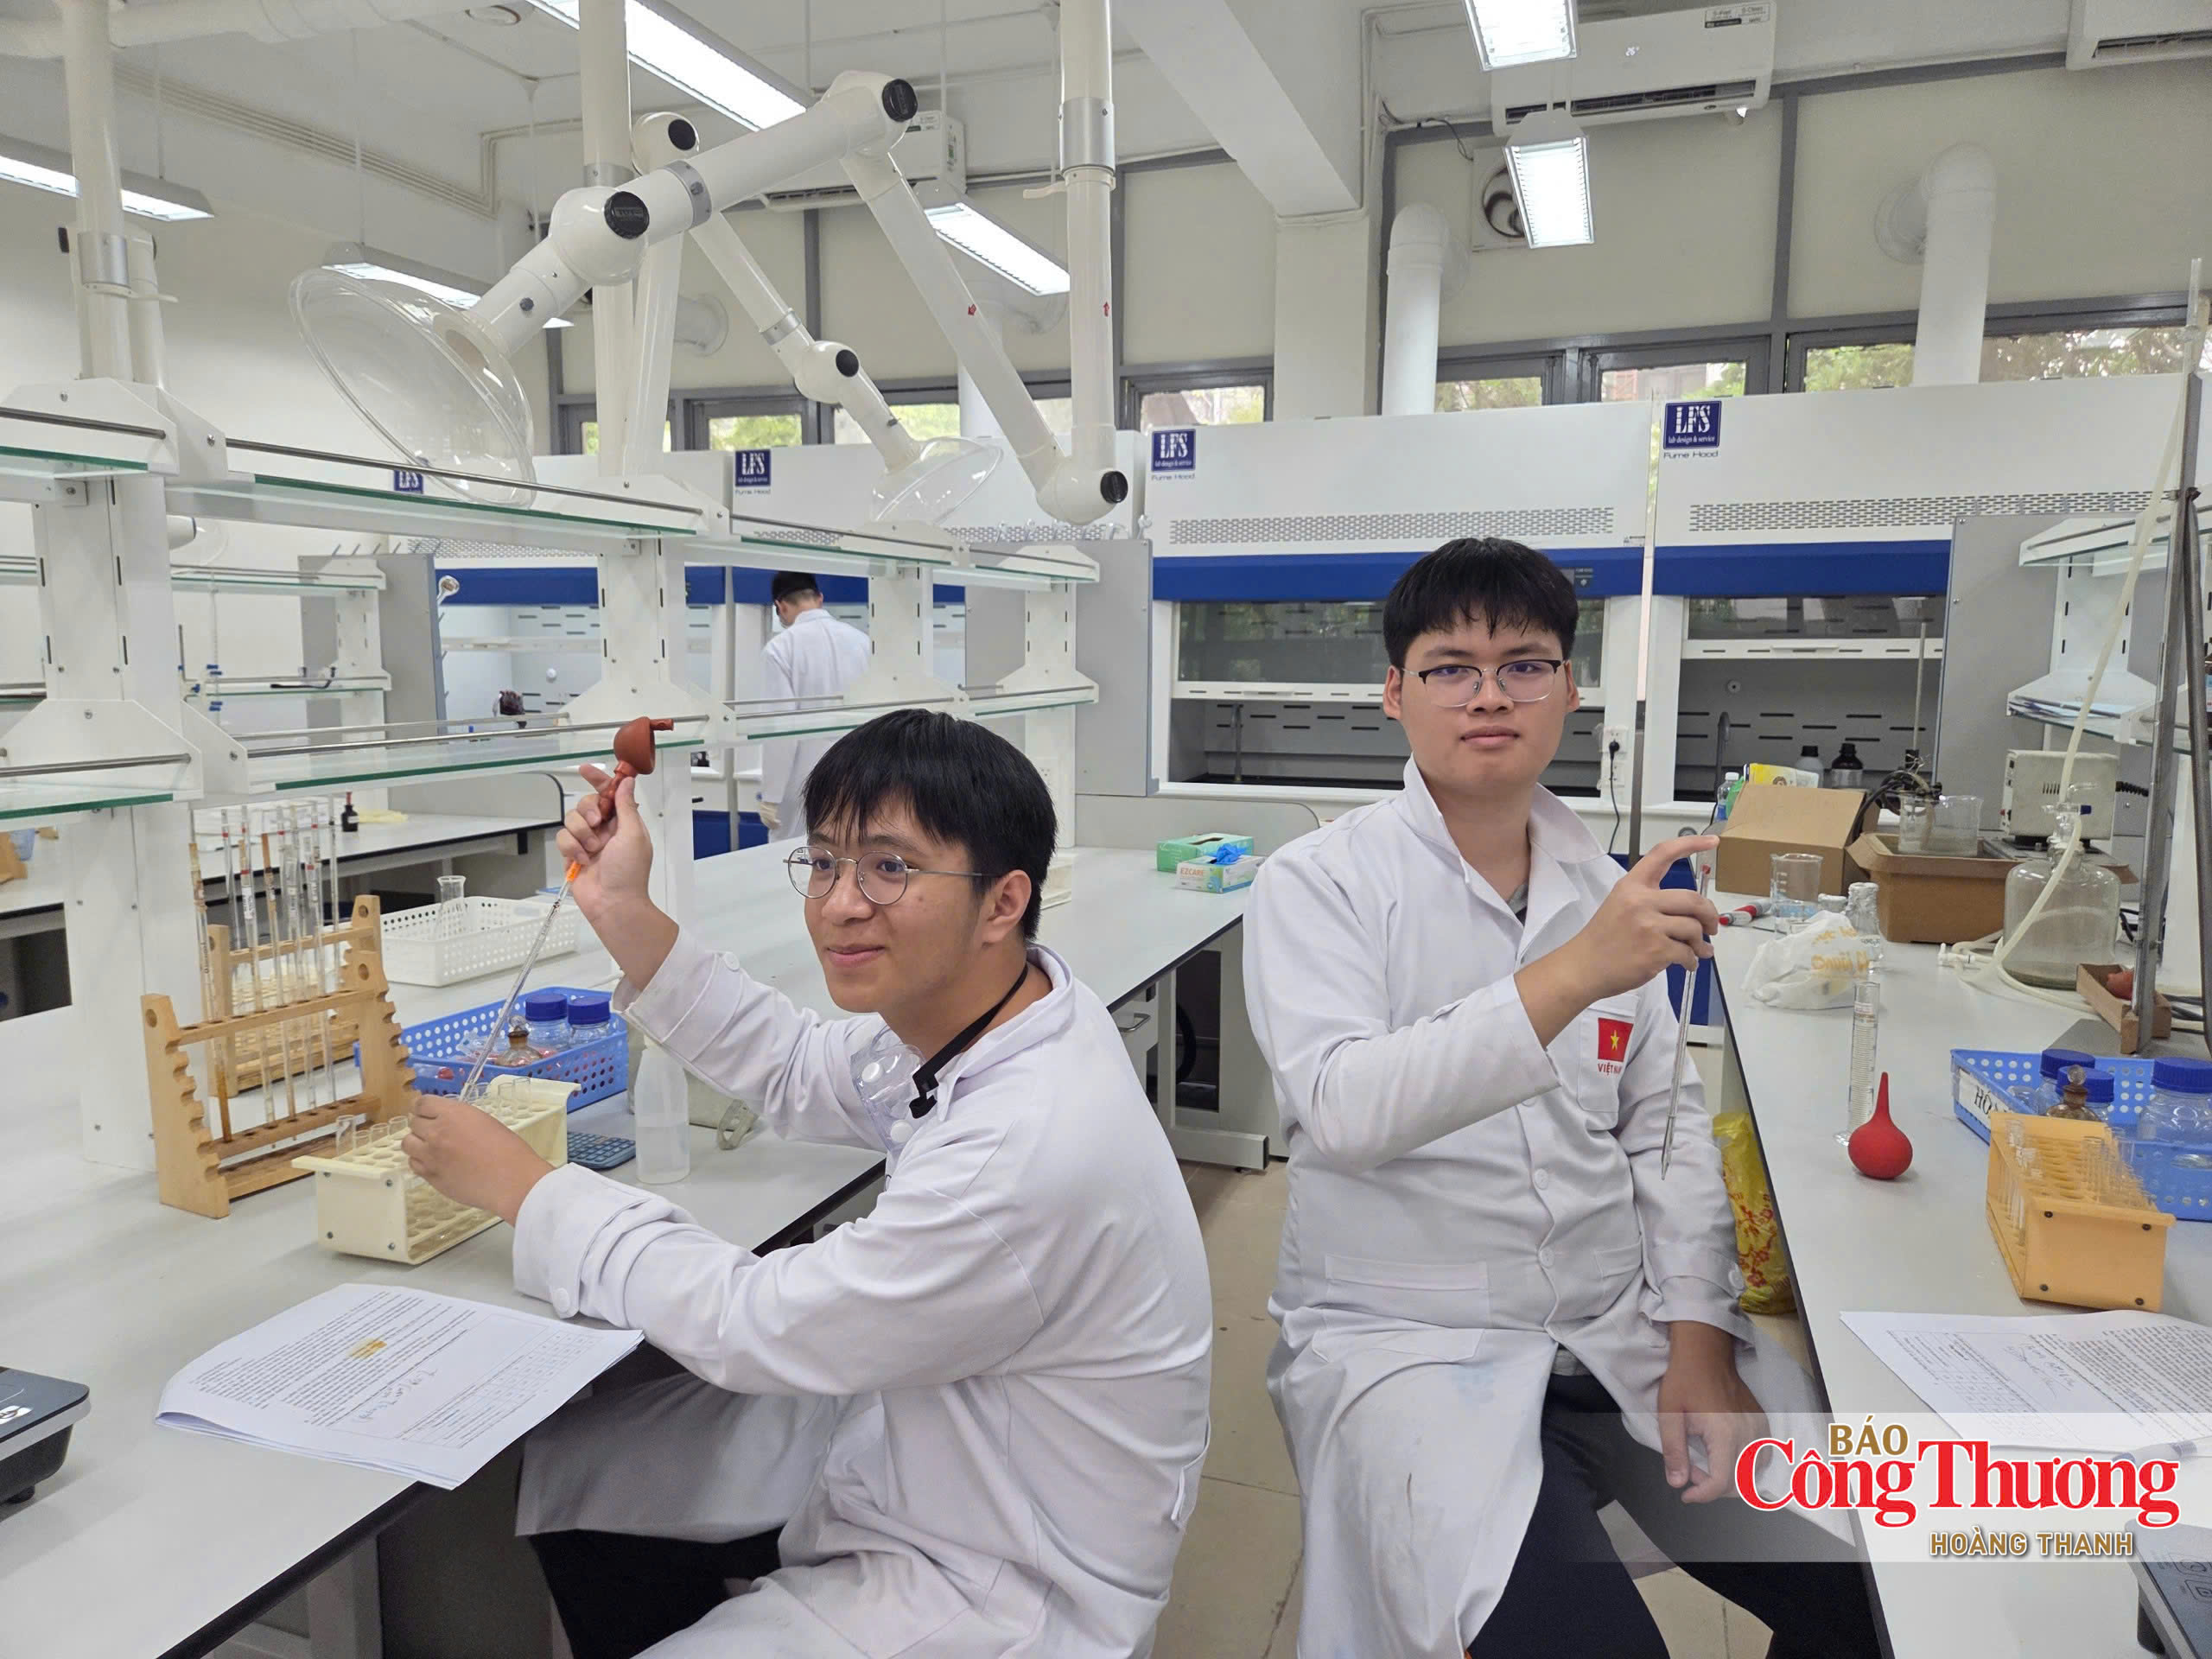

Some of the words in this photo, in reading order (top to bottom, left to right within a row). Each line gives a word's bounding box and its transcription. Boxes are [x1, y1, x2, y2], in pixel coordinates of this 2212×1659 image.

[1675, 405, 1711, 434] LFS
[1160, 433, 1188, 459] LFS
[742, 453, 765, 475] LFS
